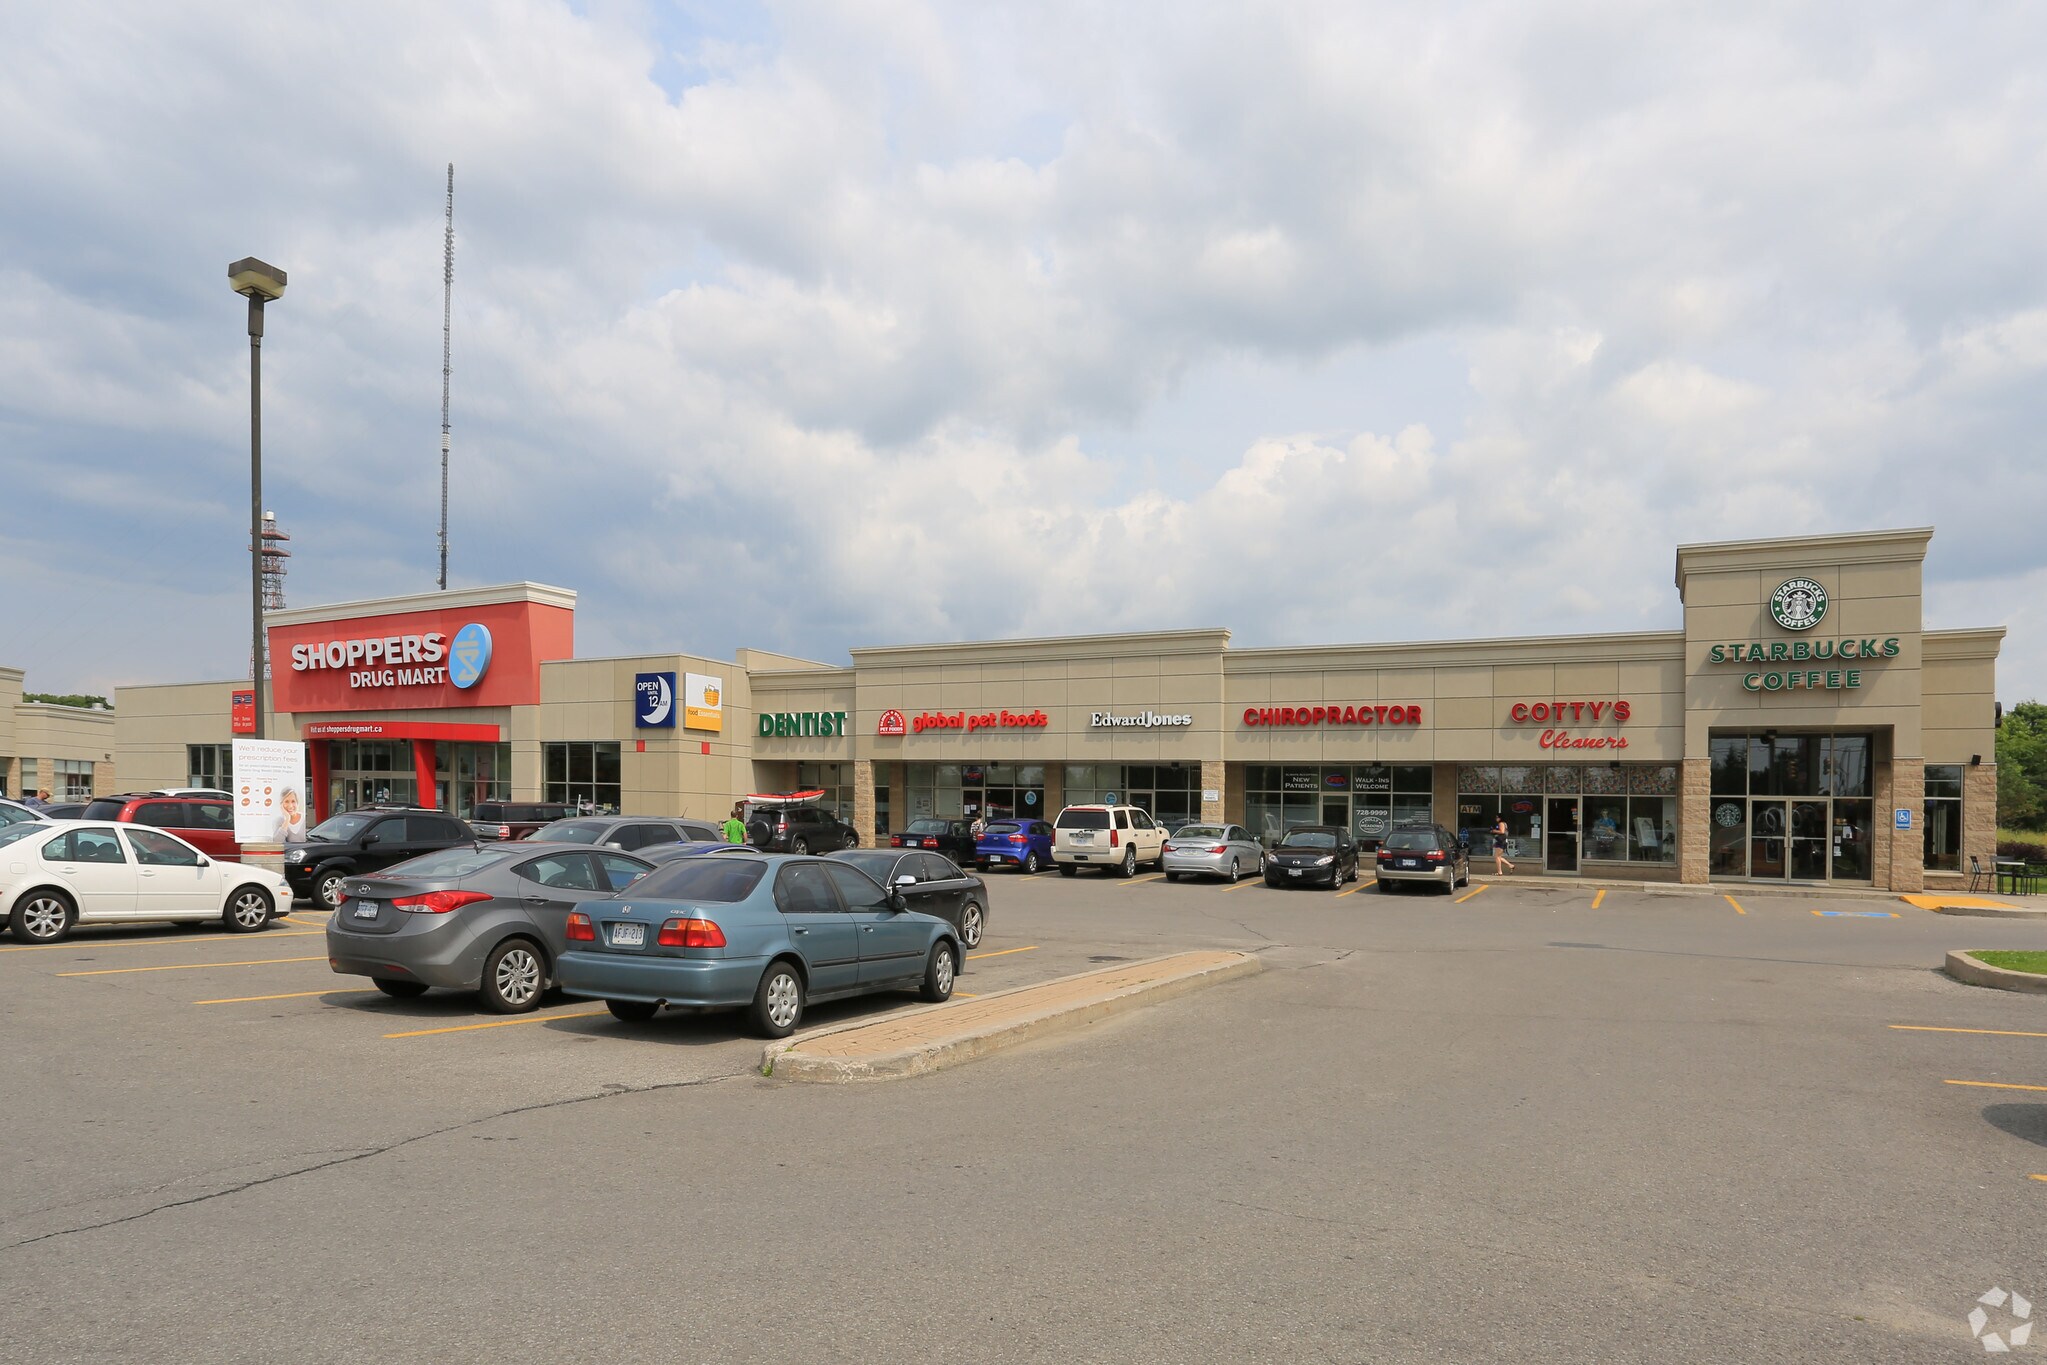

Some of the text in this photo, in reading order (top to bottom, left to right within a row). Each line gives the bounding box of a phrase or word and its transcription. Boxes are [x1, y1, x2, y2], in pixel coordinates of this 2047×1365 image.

[1774, 580, 1825, 602] STARBUCKS
[1778, 614, 1818, 627] COFFEE
[291, 632, 446, 671] SHOPPERS
[1709, 637, 1901, 663] STARBUCKS
[350, 666, 446, 688] DRUG MART
[637, 681, 659, 691] OPEN
[1743, 669, 1862, 691] COFFEE
[648, 695, 659, 707] 12
[1511, 700, 1632, 723] COTTY'S
[687, 708, 698, 716] food
[912, 710, 1048, 733] global pet foods
[1243, 705, 1422, 726] CHIROPRACTOR
[326, 725, 383, 734] shoppersdrugmart.ca
[759, 711, 848, 737] DENTIST
[1538, 729, 1629, 749] Cleaners
[631, 928, 643, 939] 213
